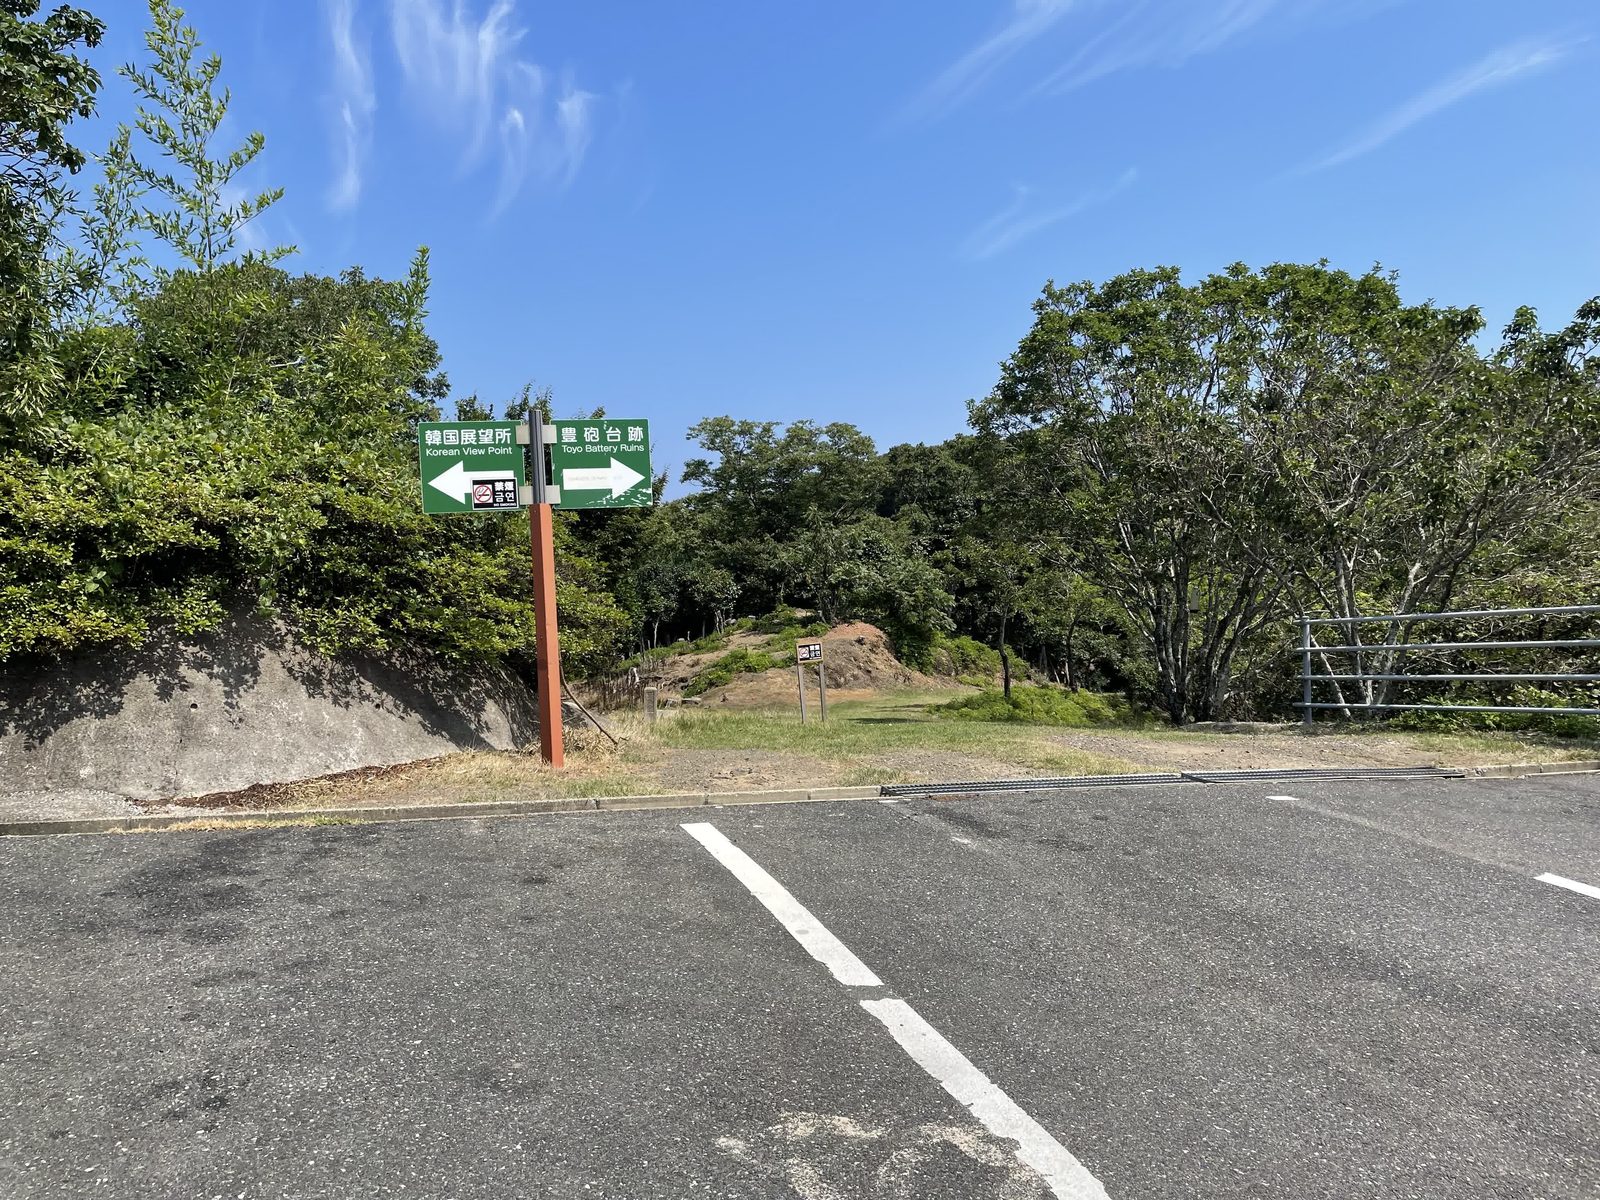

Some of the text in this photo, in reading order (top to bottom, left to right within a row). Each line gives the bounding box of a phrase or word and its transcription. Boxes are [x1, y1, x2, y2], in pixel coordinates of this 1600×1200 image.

[425, 428, 512, 446] 韓国展望所
[561, 426, 643, 442] 豊砲台跡
[426, 446, 513, 456] Korean View Point
[562, 443, 644, 454] Toyo Battery Ruins
[494, 492, 515, 502] 금연
